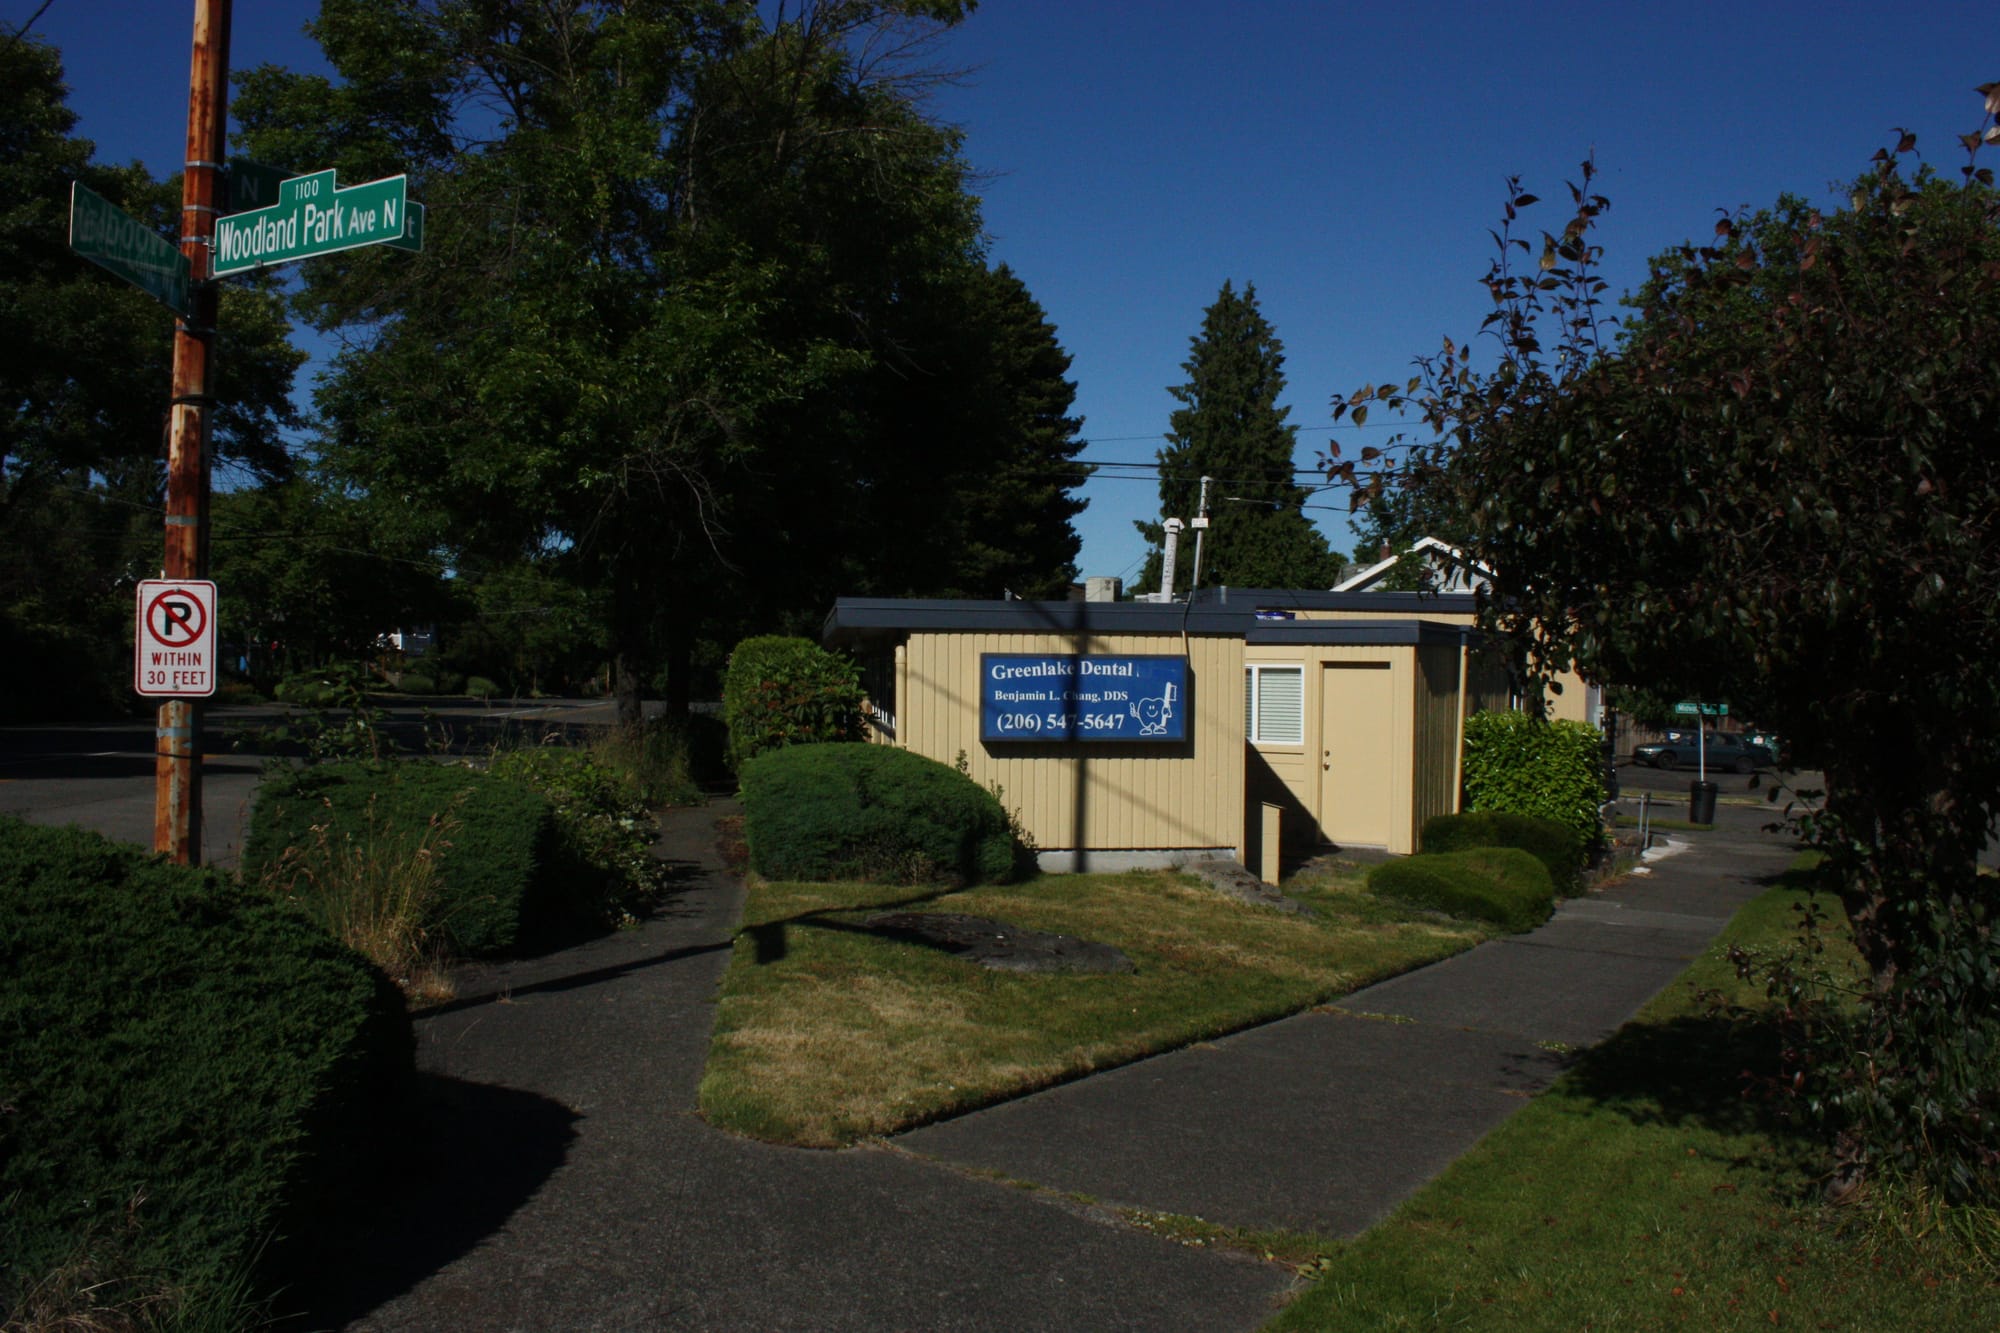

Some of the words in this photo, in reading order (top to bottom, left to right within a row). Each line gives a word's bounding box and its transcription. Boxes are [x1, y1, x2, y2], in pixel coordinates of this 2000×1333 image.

[240, 174, 258, 202] N
[295, 179, 319, 201] 1100
[218, 208, 298, 262] Woodland
[304, 199, 344, 246] Park
[347, 207, 376, 237] Ave
[383, 198, 397, 228] N
[152, 652, 202, 666] WITHIN
[147, 671, 166, 685] 30
[173, 671, 206, 685] FEET
[991, 661, 1075, 680] Greenlake
[1080, 661, 1133, 677] Dental
[994, 690, 1046, 703] Benjamin
[1049, 691, 1061, 701] L.
[1063, 690, 1101, 703] Chang,
[1104, 691, 1129, 701] DDS
[996, 713, 1042, 733] (206)
[1046, 713, 1125, 730] 547-5647
